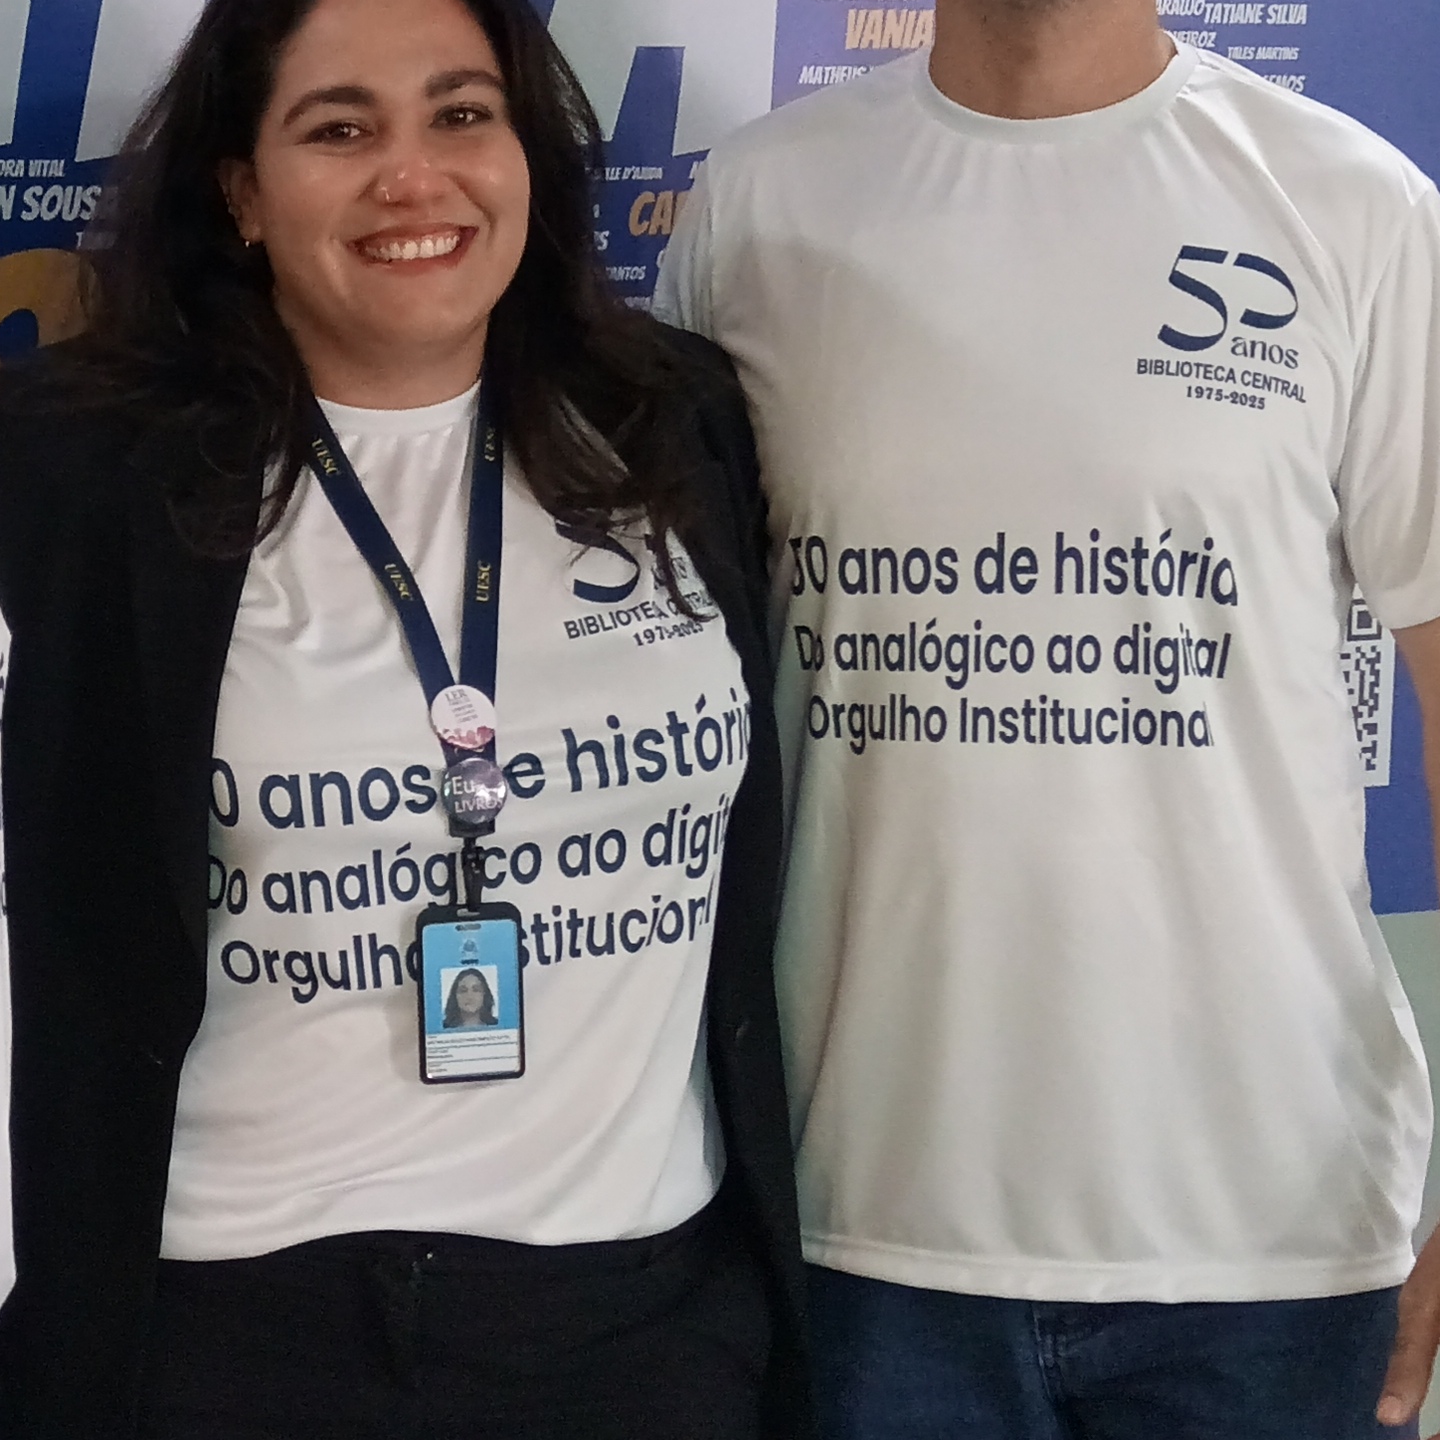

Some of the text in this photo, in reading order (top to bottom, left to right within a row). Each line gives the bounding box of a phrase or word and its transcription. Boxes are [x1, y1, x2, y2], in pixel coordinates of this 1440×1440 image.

[1204, 4, 1307, 24] TATIANE SILVA
[1137, 358, 1306, 403] BIBLIOTECA CENTRAL
[1230, 336, 1299, 369] anos
[1186, 386, 1266, 410] 1975-2025
[838, 545, 959, 596] anos
[974, 532, 1039, 595] de
[1054, 527, 1238, 606] história
[833, 618, 1034, 690] analógico
[1046, 634, 1102, 674] ao
[1113, 621, 1231, 695] digital
[808, 693, 947, 756] Orgulho
[211, 687, 751, 829] 0 anos e históri
[262, 842, 542, 914] analógco
[557, 828, 627, 879] ao
